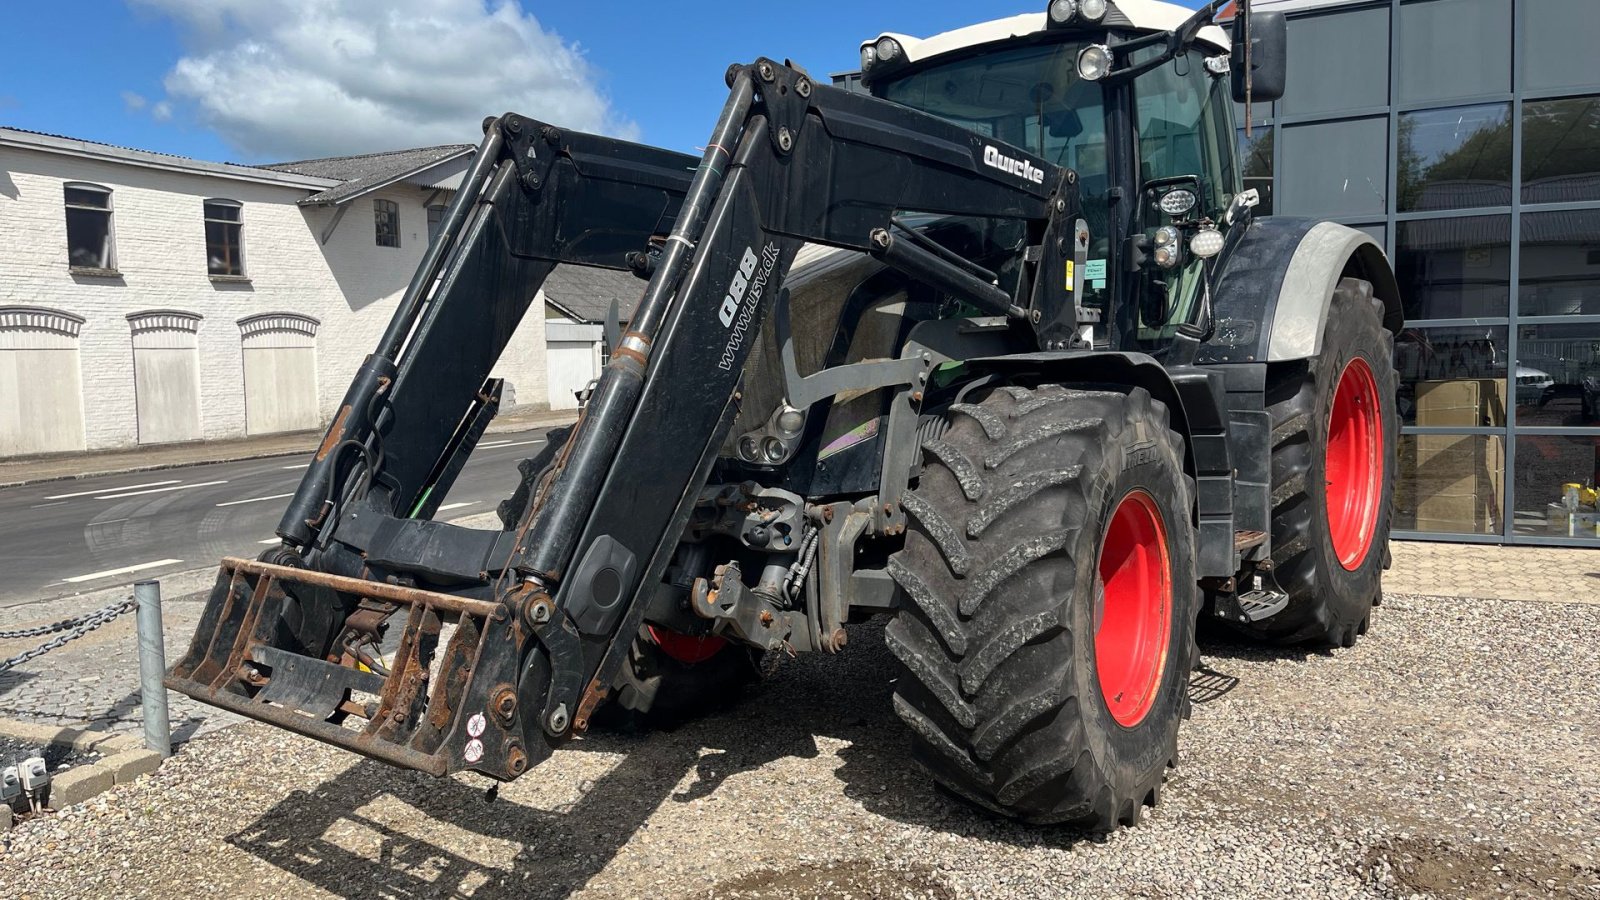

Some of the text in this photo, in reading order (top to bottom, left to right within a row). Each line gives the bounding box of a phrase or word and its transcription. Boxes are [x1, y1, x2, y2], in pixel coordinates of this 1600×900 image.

[983, 145, 1044, 184] Quicke
[718, 246, 758, 328] Q88
[718, 241, 780, 371] www.usv.dk
